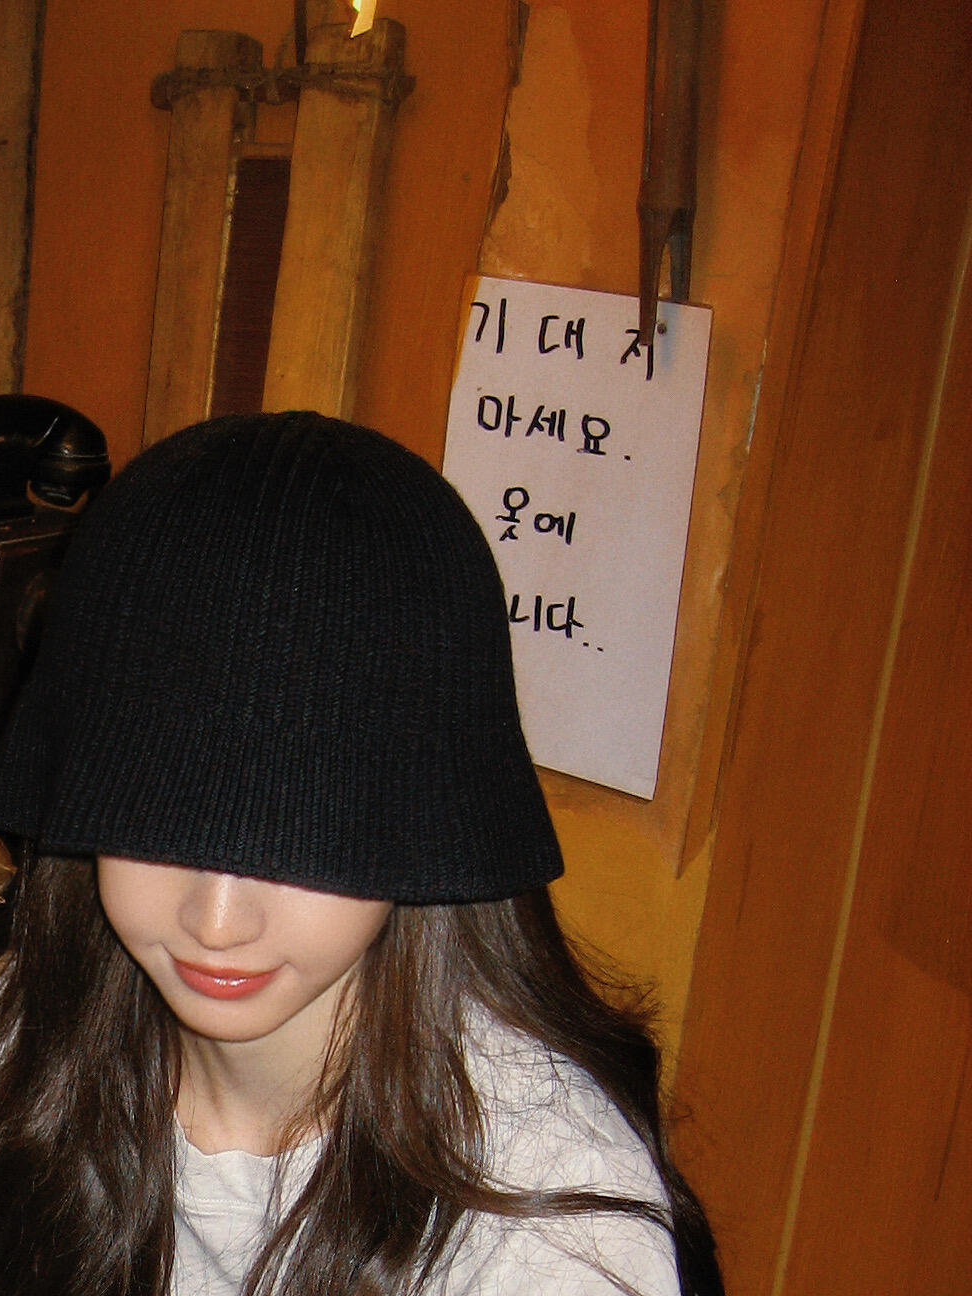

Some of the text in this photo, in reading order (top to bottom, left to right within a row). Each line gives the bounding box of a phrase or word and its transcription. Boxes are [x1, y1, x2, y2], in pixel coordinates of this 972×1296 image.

[477, 394, 631, 461] 마세요.
[495, 487, 577, 546] 옷에
[508, 593, 604, 653] 니다..
